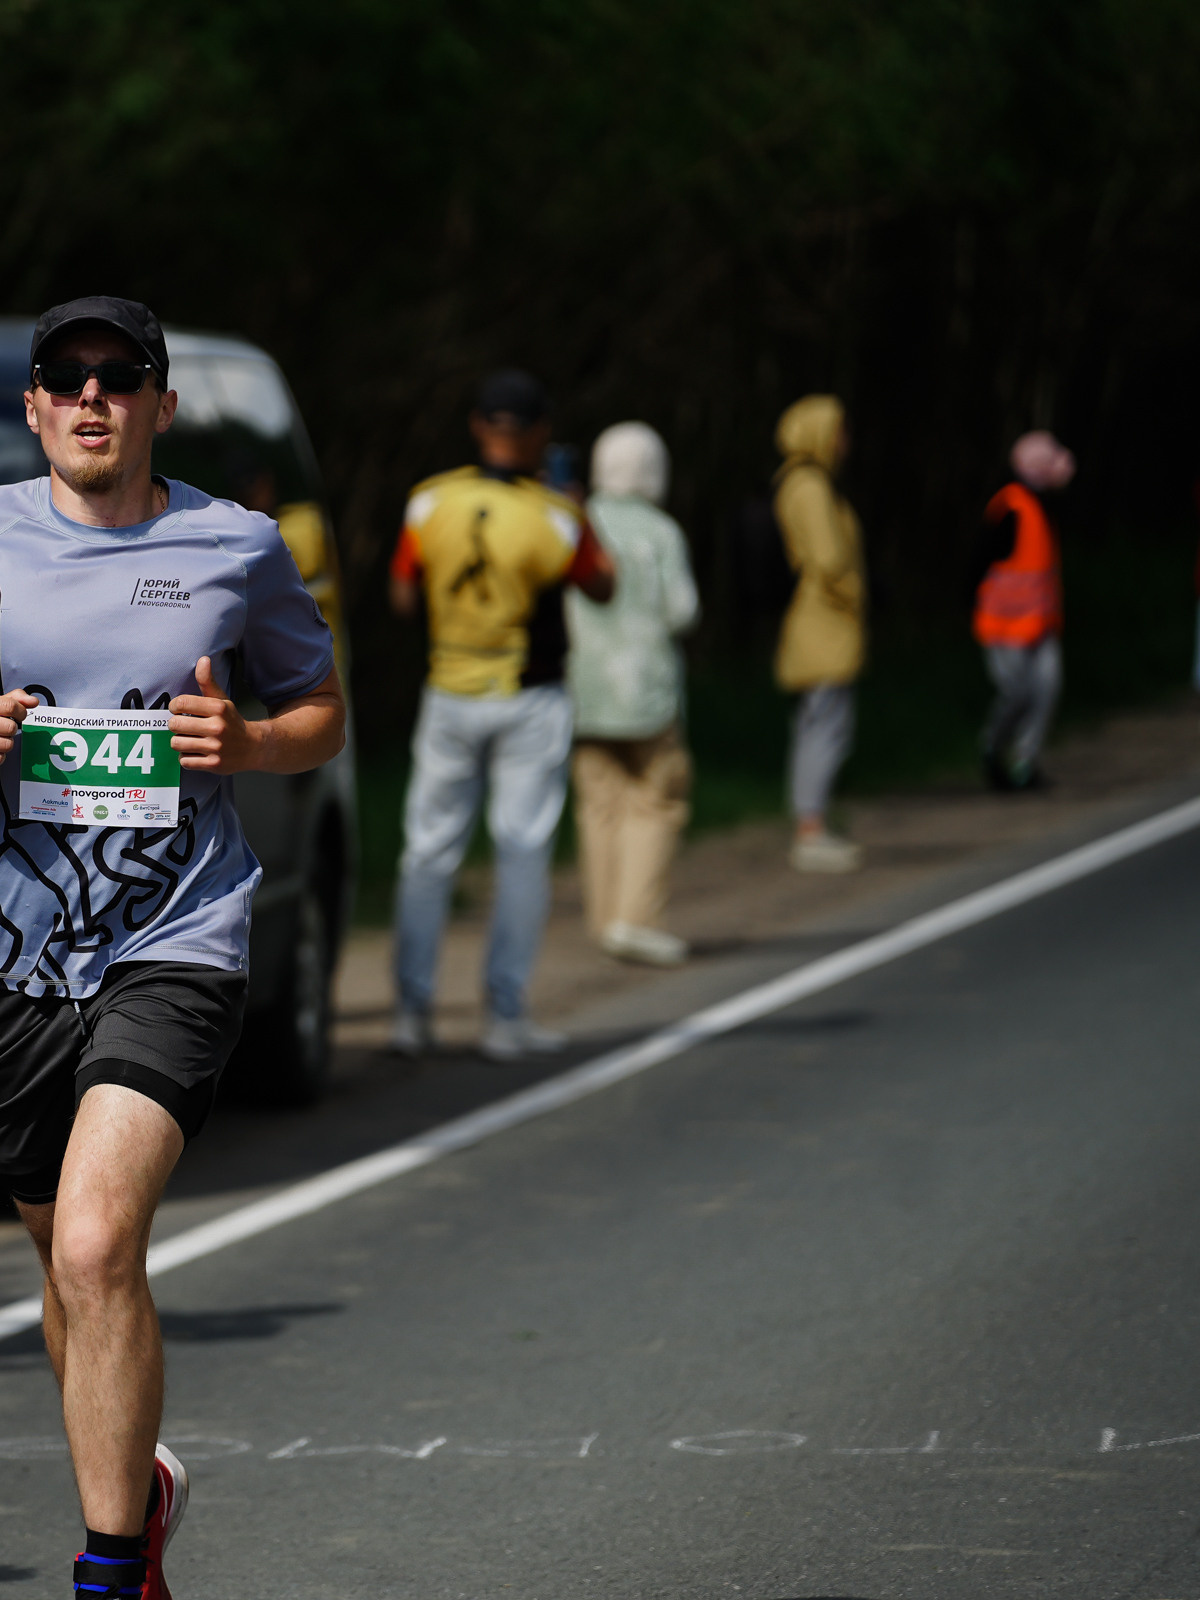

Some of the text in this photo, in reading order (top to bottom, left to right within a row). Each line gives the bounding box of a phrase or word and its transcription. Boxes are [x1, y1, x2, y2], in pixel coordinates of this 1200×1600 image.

[143, 578, 181, 589] ЮРИЙ
[140, 589, 191, 601] СЕРГЕЕВ
[138, 600, 191, 609] #NOVGORODRUN
[34, 715, 169, 727] НОВГОРОДСКИЙ ТРИАТЛОН 202
[49, 731, 155, 774] Э44
